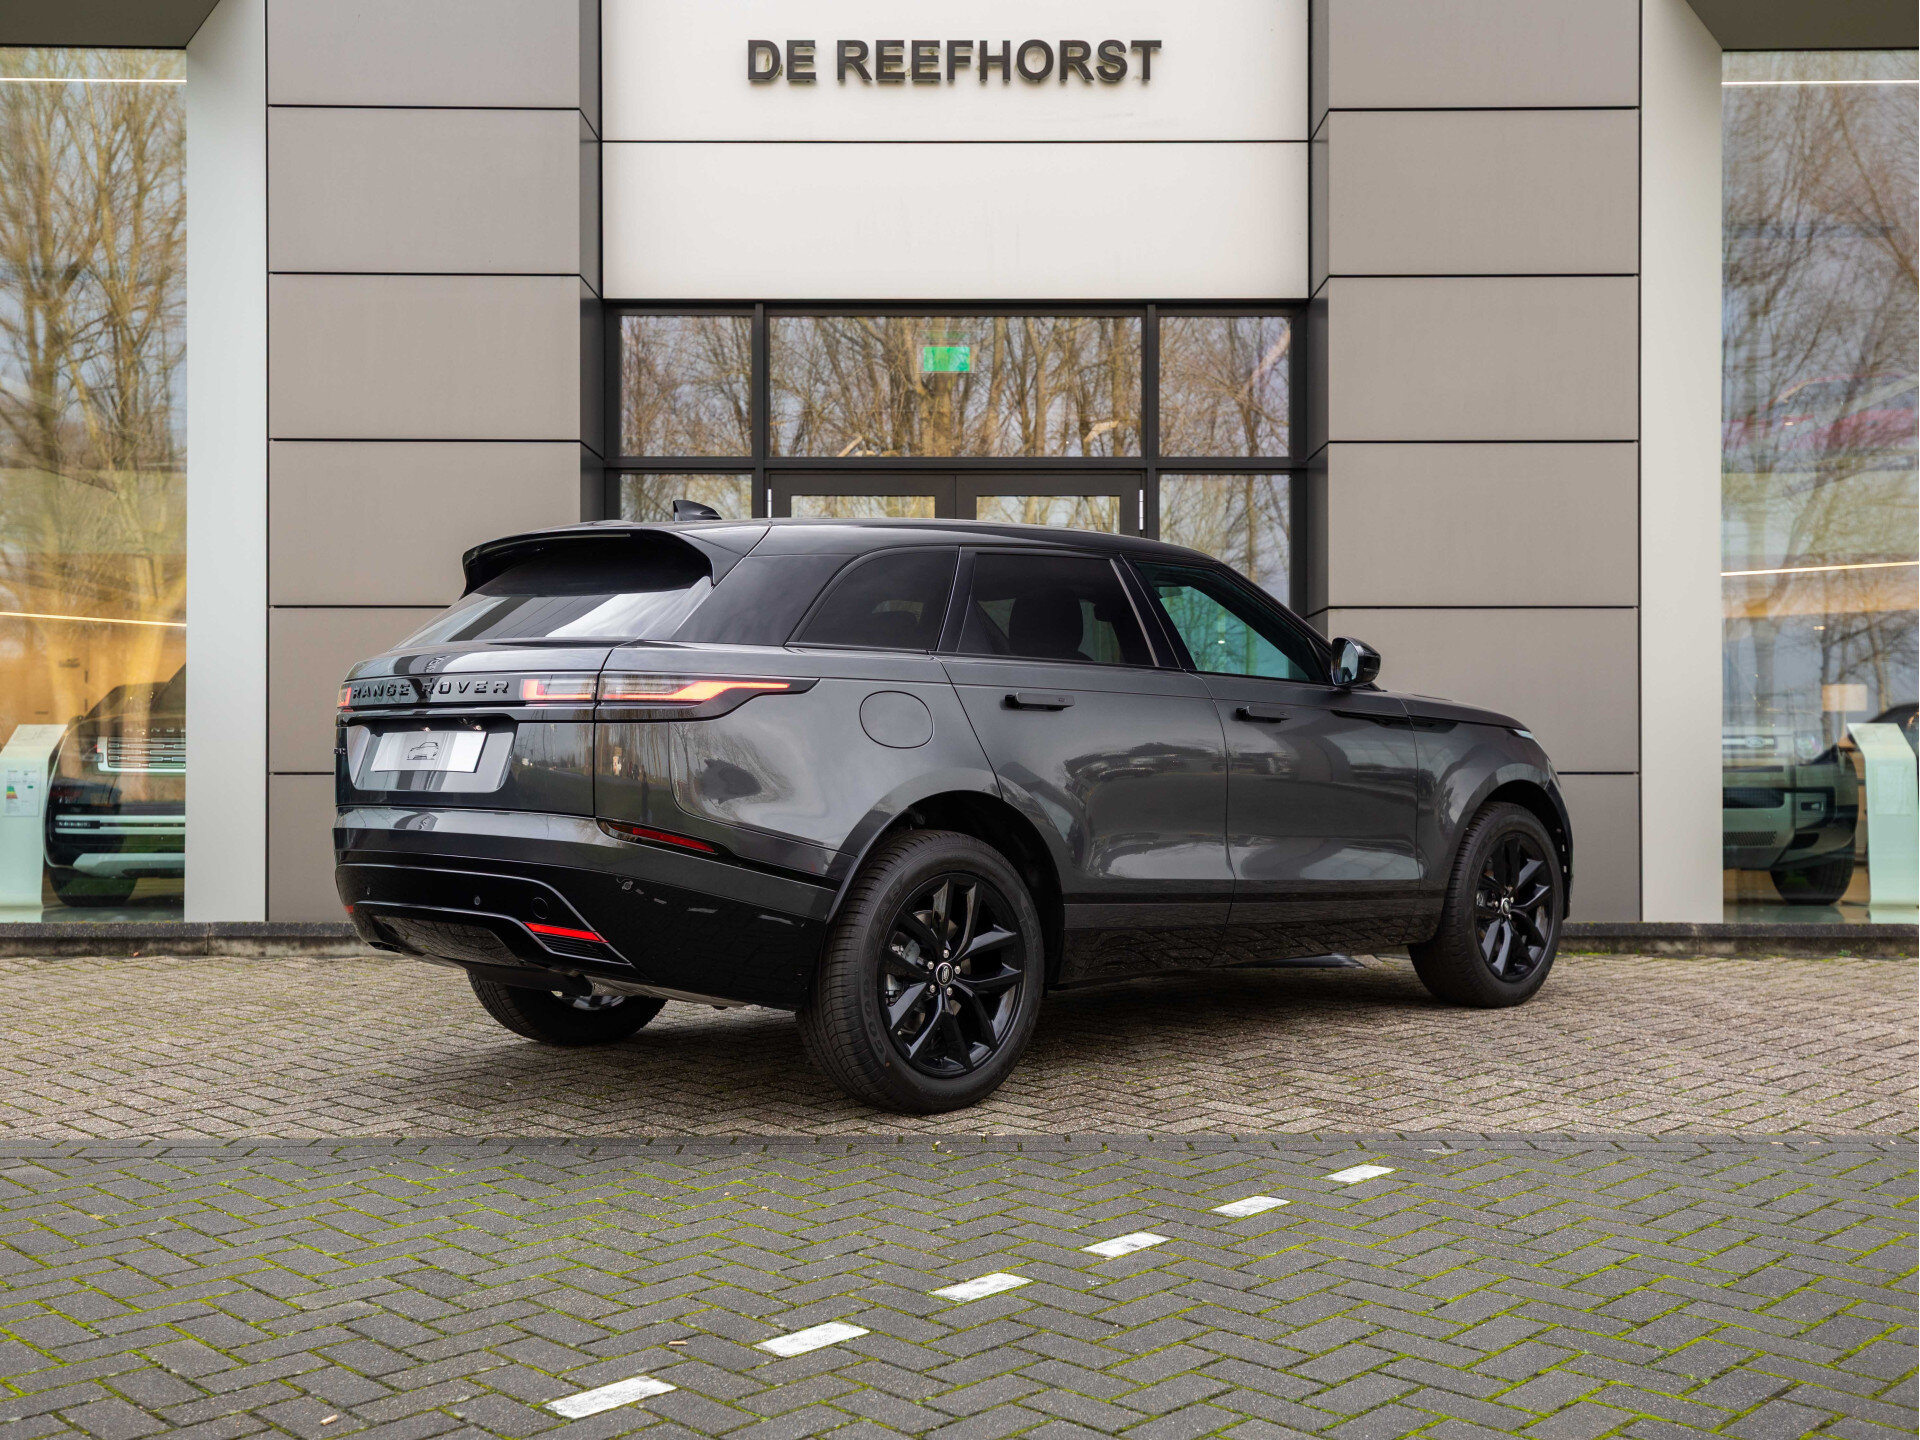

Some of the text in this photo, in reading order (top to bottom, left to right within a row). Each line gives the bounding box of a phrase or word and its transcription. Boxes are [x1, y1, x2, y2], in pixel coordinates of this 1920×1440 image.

[747, 39, 1162, 83] DE REEFHORST
[352, 680, 510, 700] RANGE ROVER
